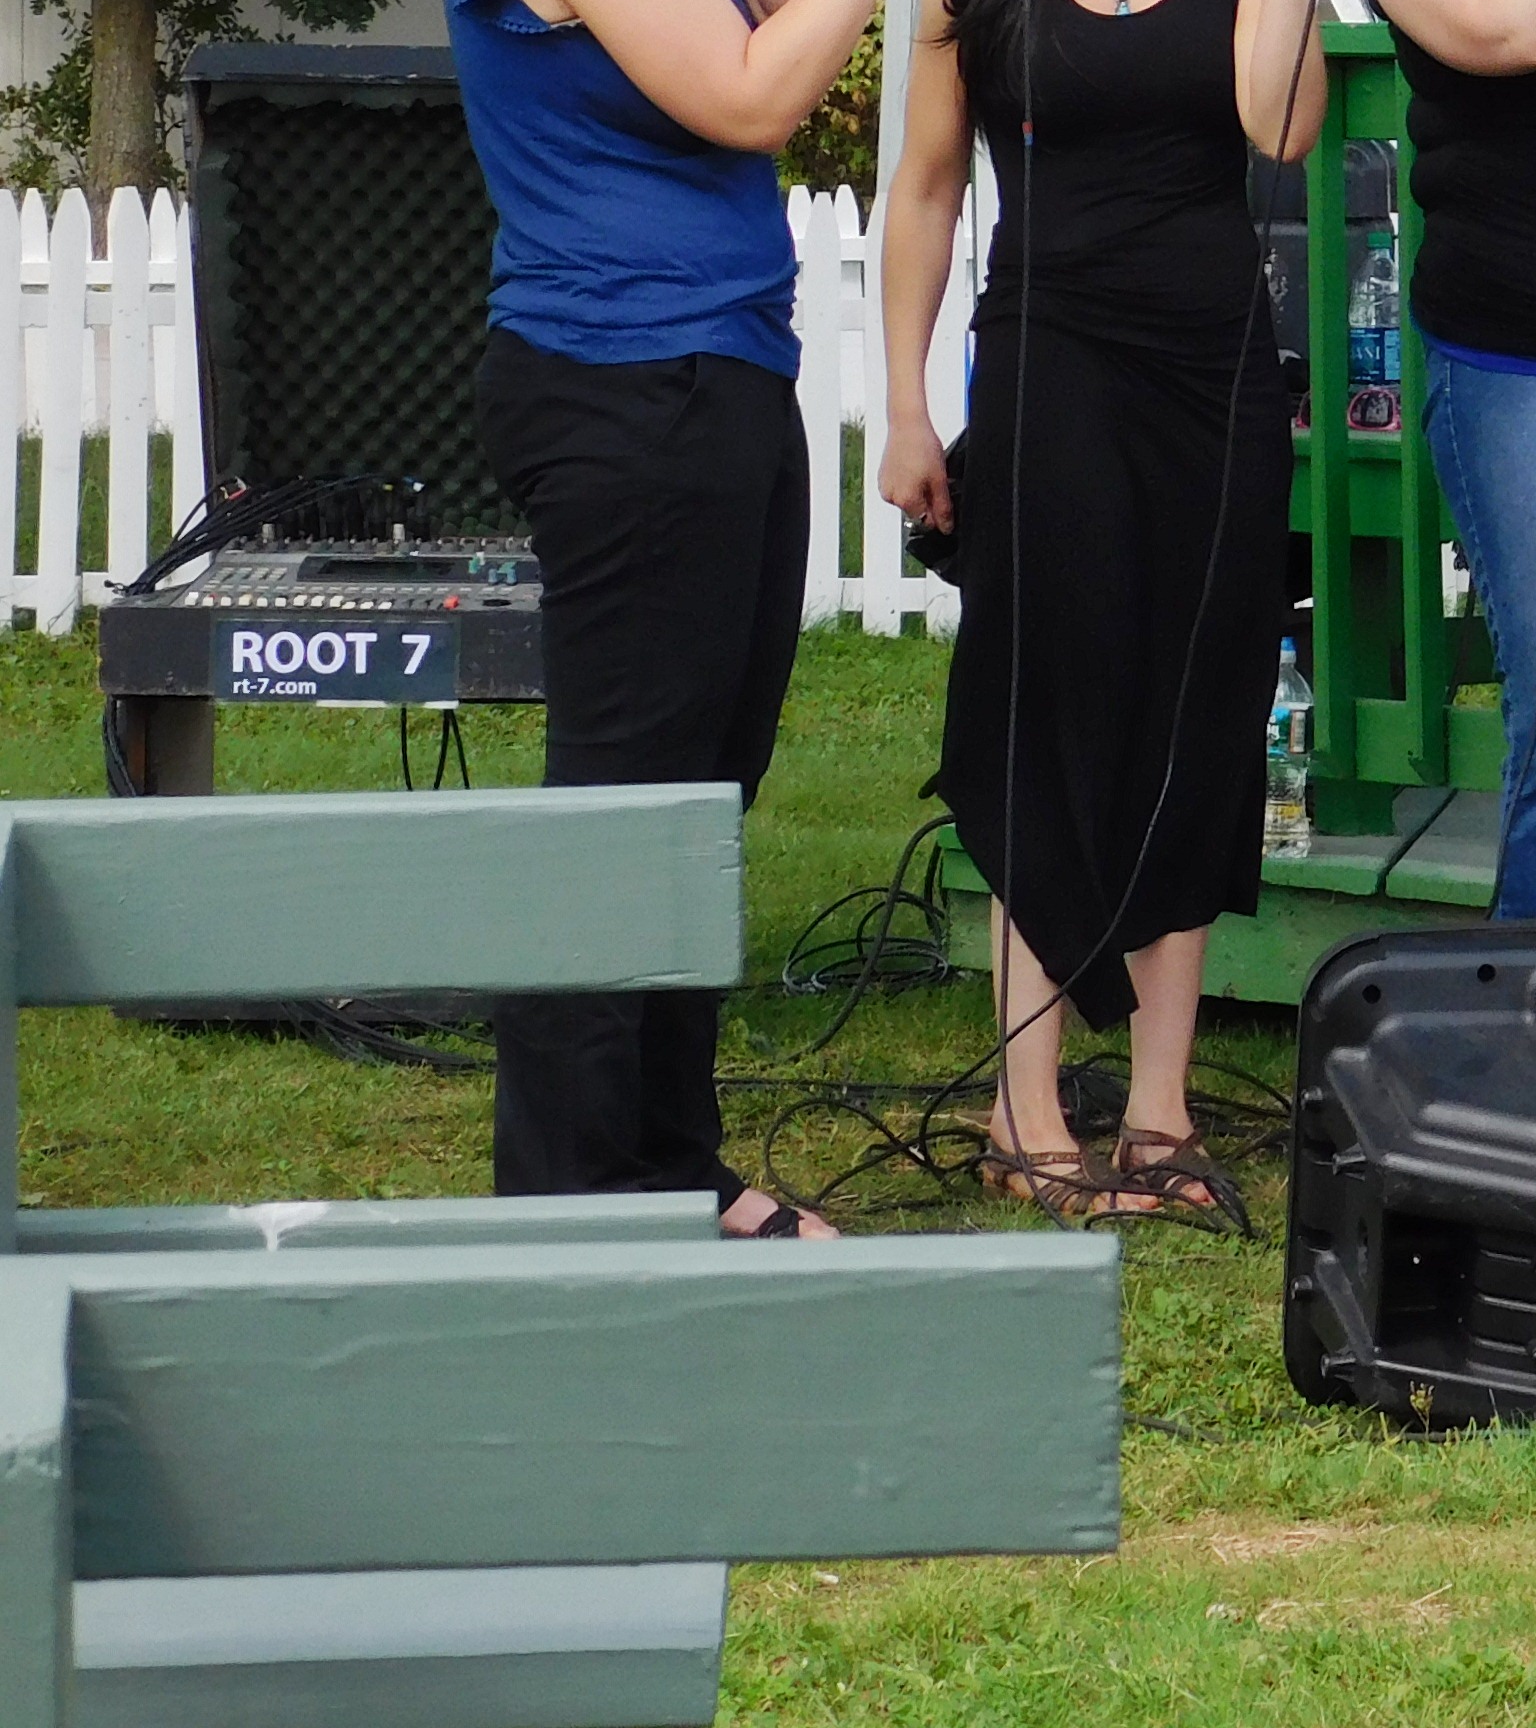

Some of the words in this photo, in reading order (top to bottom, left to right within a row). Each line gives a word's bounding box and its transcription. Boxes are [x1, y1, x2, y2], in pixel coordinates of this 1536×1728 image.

[232, 630, 377, 674] ROOT
[401, 633, 432, 676] 7
[232, 677, 317, 696] rt-7.com
